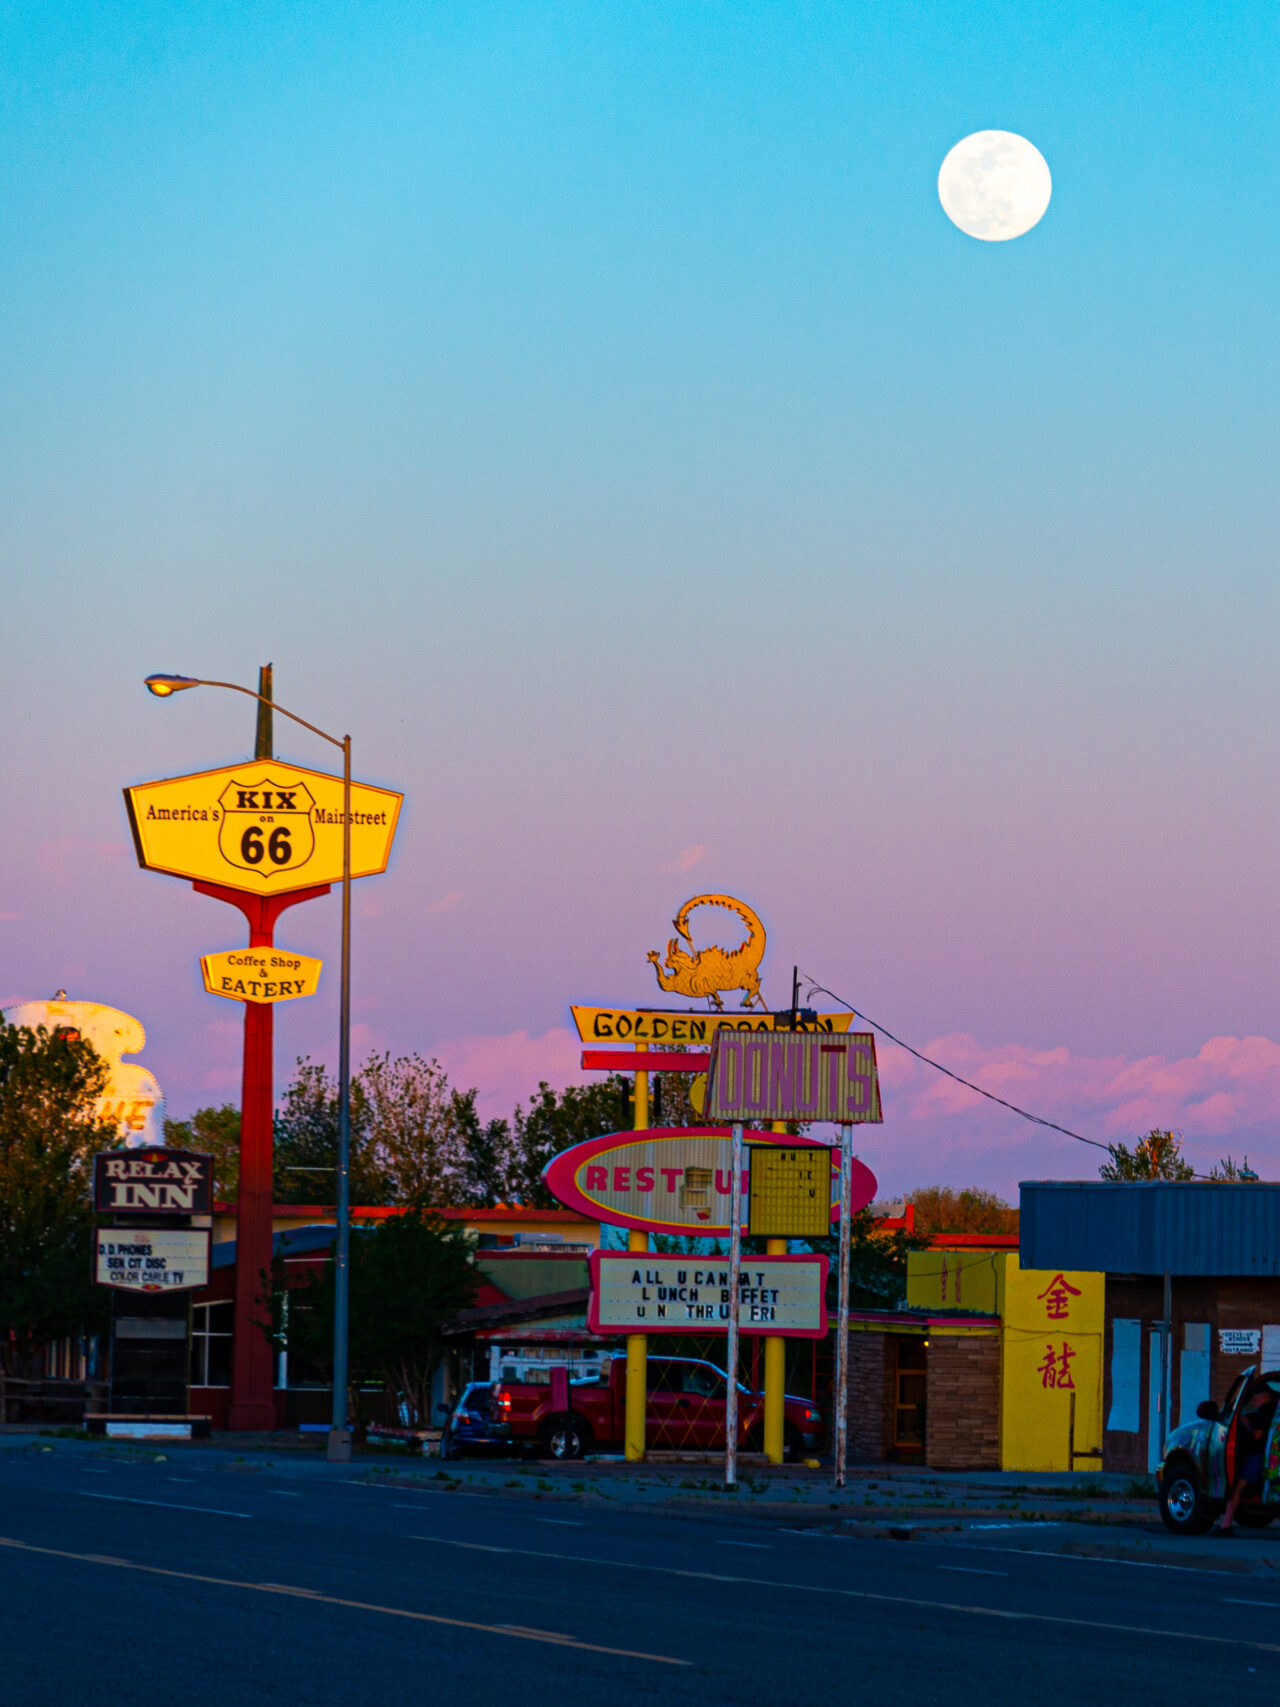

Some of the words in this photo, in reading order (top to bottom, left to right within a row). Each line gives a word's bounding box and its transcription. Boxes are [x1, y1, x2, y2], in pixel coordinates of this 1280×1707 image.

[236, 791, 297, 809] KIX
[146, 805, 220, 821] America's
[260, 815, 274, 823] on
[241, 826, 292, 865] 66
[228, 955, 266, 967] Coffee
[270, 957, 301, 970] Shop
[259, 969, 268, 978] &
[221, 977, 306, 997] EATERY
[593, 1013, 706, 1040] GOLDEN
[719, 1040, 871, 1113] DONUTS
[105, 1159, 204, 1184] RELAX
[110, 1182, 198, 1209] INN
[118, 1244, 153, 1255] PHONES
[145, 1258, 167, 1269] DISC
[110, 1271, 138, 1281] COLOR
[173, 1272, 184, 1283] TV
[632, 1270, 663, 1285] ALL
[720, 1289, 779, 1304] BFFET
[686, 1305, 731, 1320] THRU
[750, 1306, 776, 1321] FRI
[1037, 1273, 1082, 1389] 金龍
